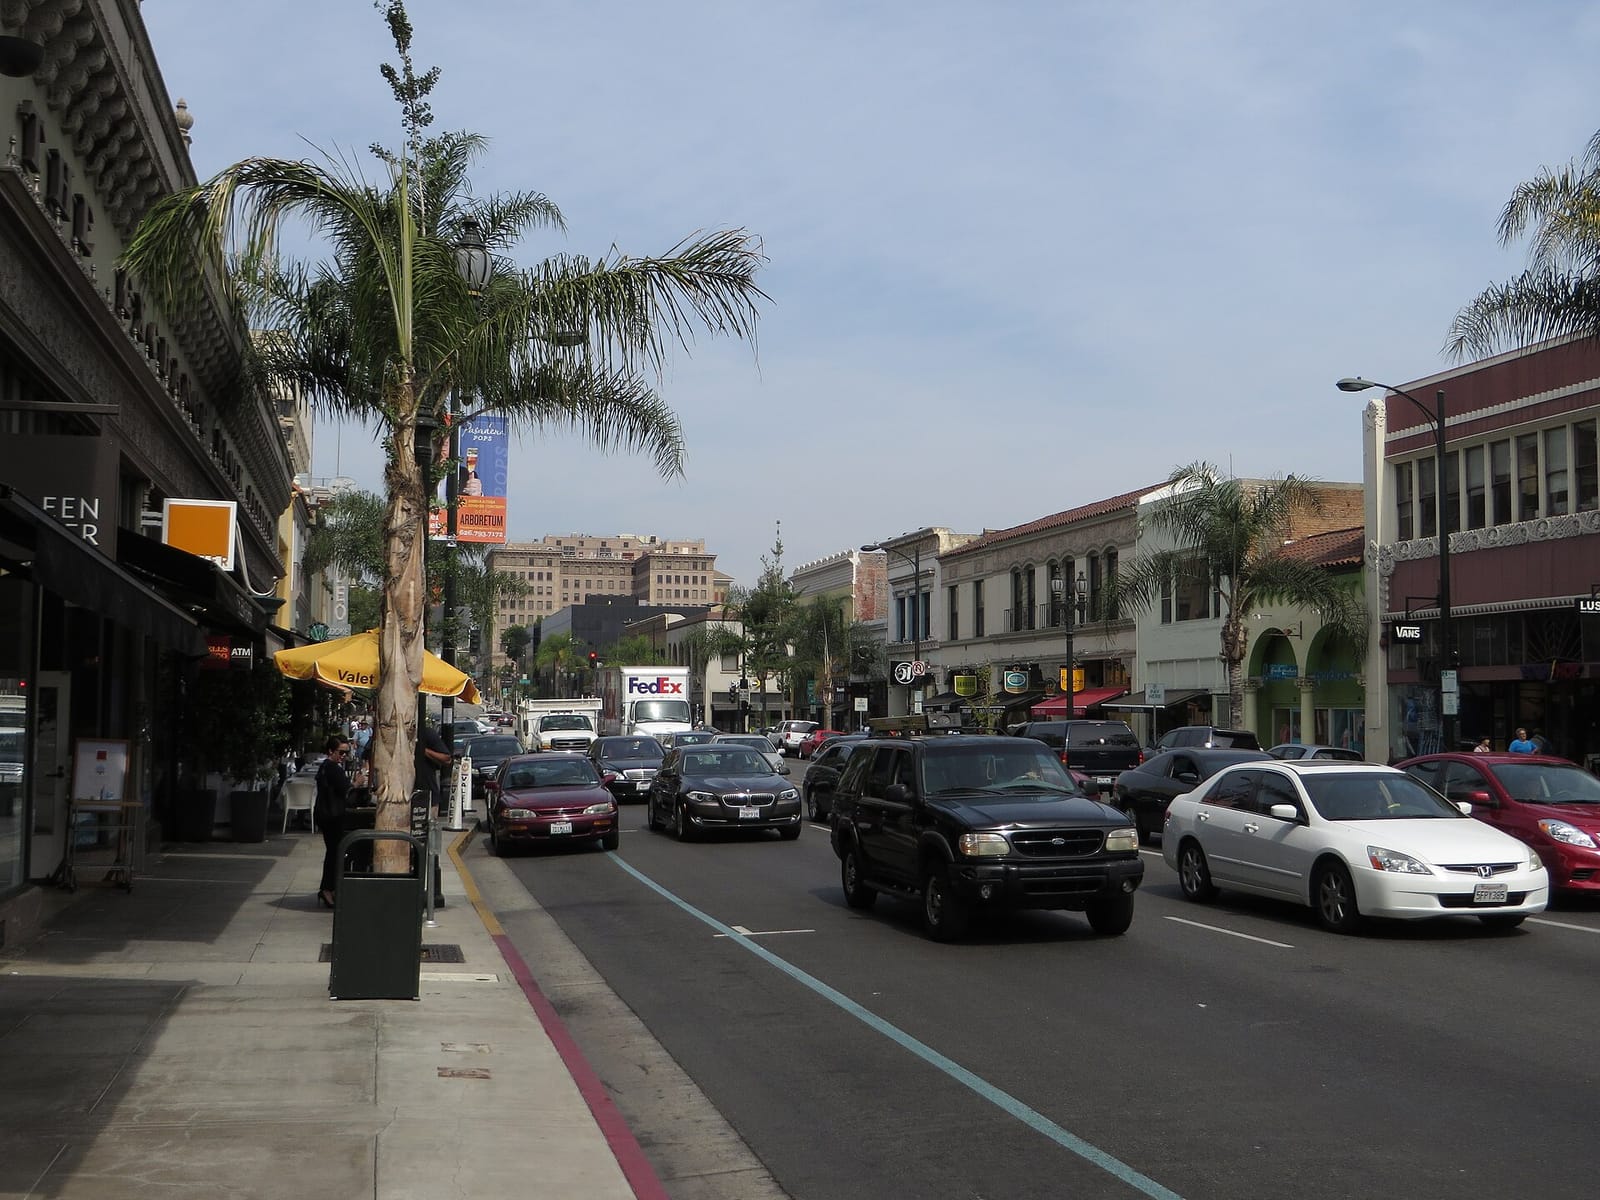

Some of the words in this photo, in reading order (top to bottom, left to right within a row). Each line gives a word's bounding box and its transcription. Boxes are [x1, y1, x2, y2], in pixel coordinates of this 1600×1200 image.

[460, 514, 503, 527] ARBORETUM
[231, 647, 251, 656] ATM
[338, 669, 375, 685] Valet
[628, 676, 683, 694] FedEx
[448, 788, 457, 823] VALET
